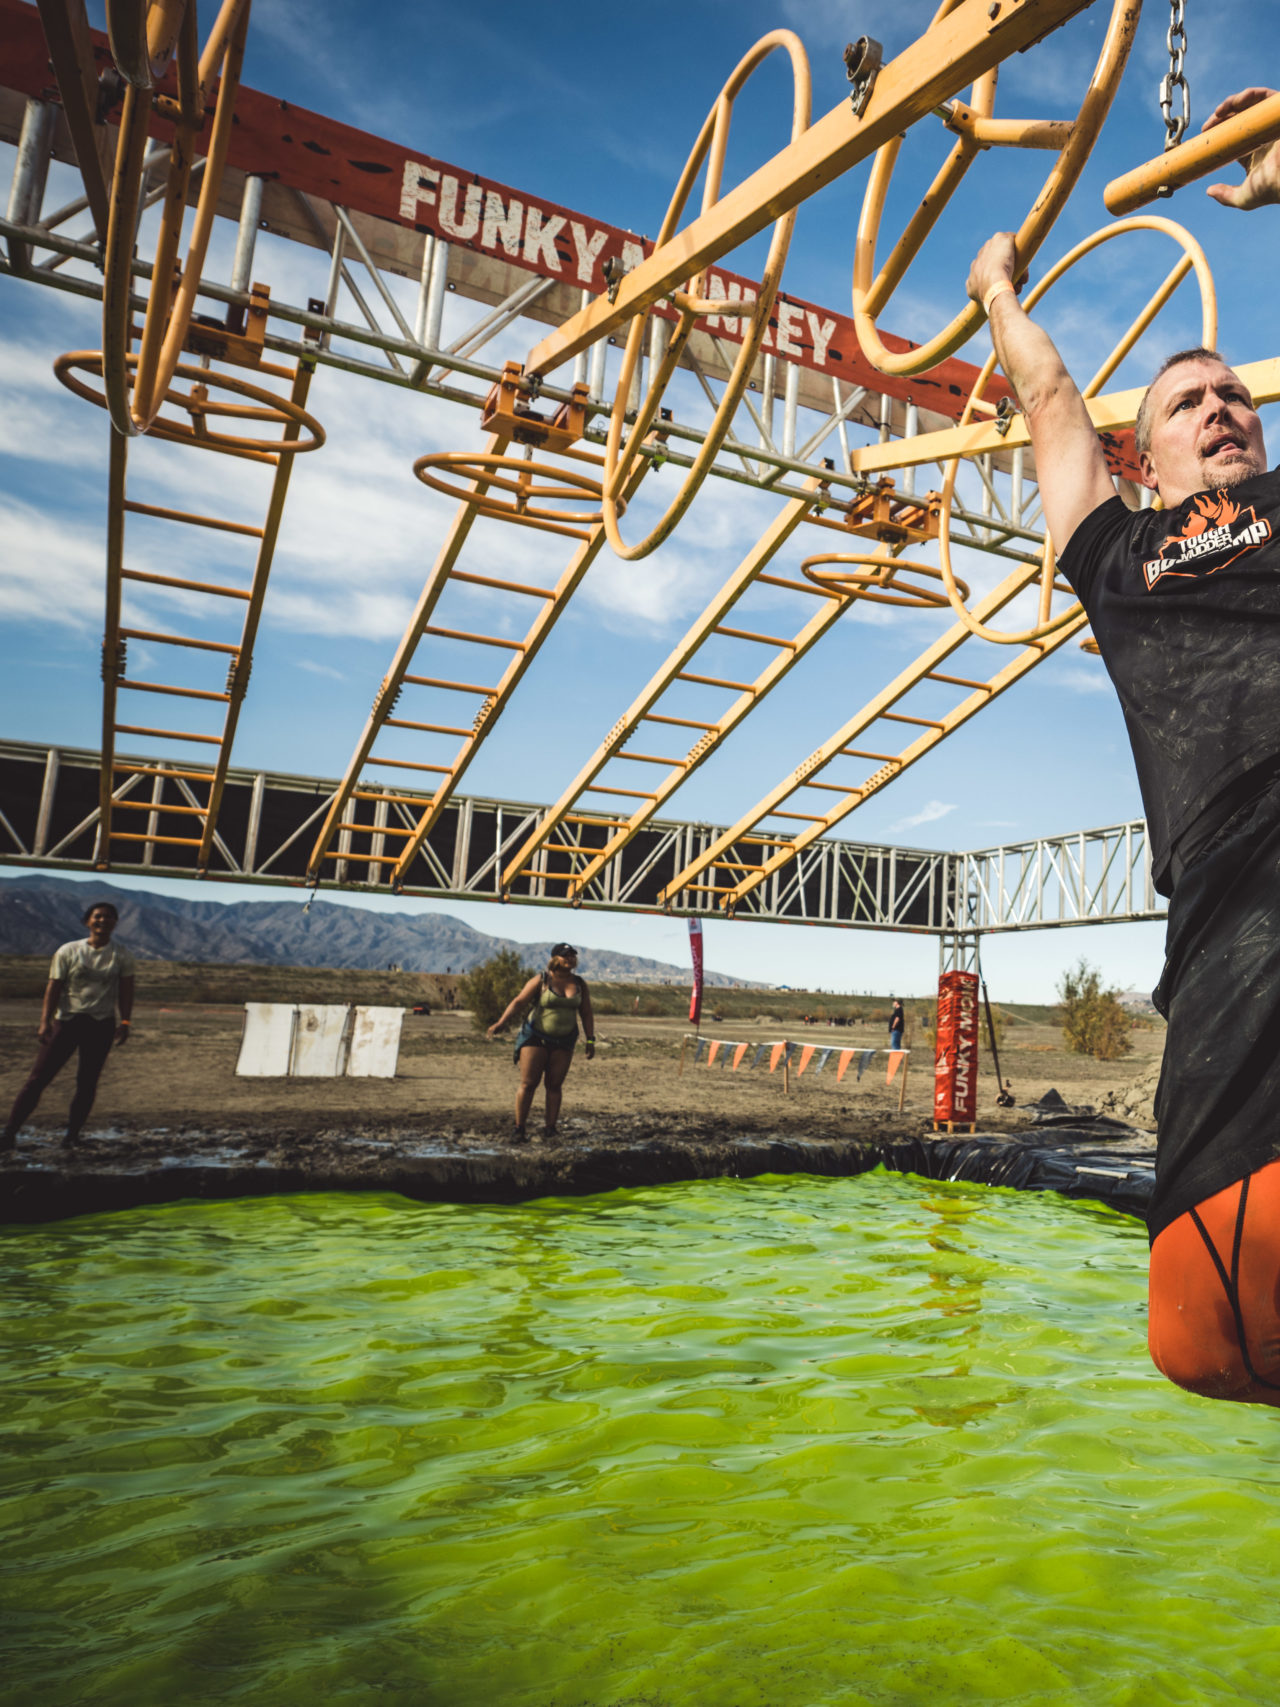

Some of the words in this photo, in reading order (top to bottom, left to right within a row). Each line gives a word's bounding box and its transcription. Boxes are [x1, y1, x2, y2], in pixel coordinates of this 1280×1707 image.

[399, 159, 609, 283] FUNKY
[621, 240, 837, 366] NKEY
[1146, 521, 1268, 584] BOMP
[1178, 523, 1231, 554] TOUGH
[1180, 534, 1234, 561] MUDDER
[954, 1035, 973, 1113] FUNKY
